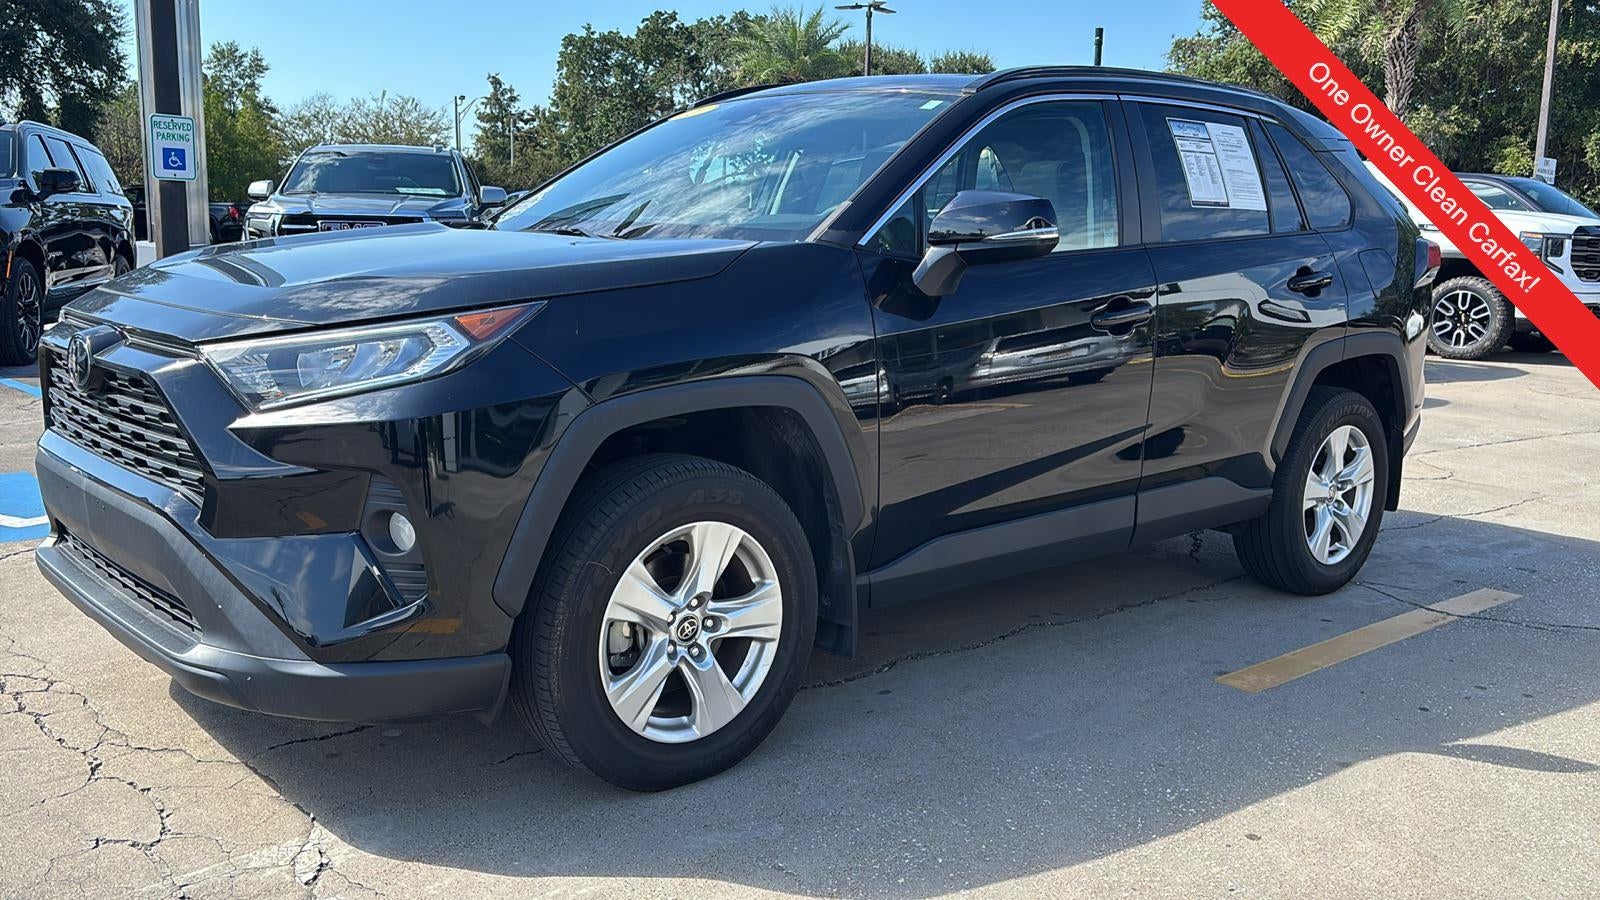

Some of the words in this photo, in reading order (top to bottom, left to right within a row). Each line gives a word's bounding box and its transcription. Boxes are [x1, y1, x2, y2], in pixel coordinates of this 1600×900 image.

[153, 120, 192, 132] RESERVED
[156, 131, 190, 143] PARKING
[1319, 403, 1374, 438] COUNTRY
